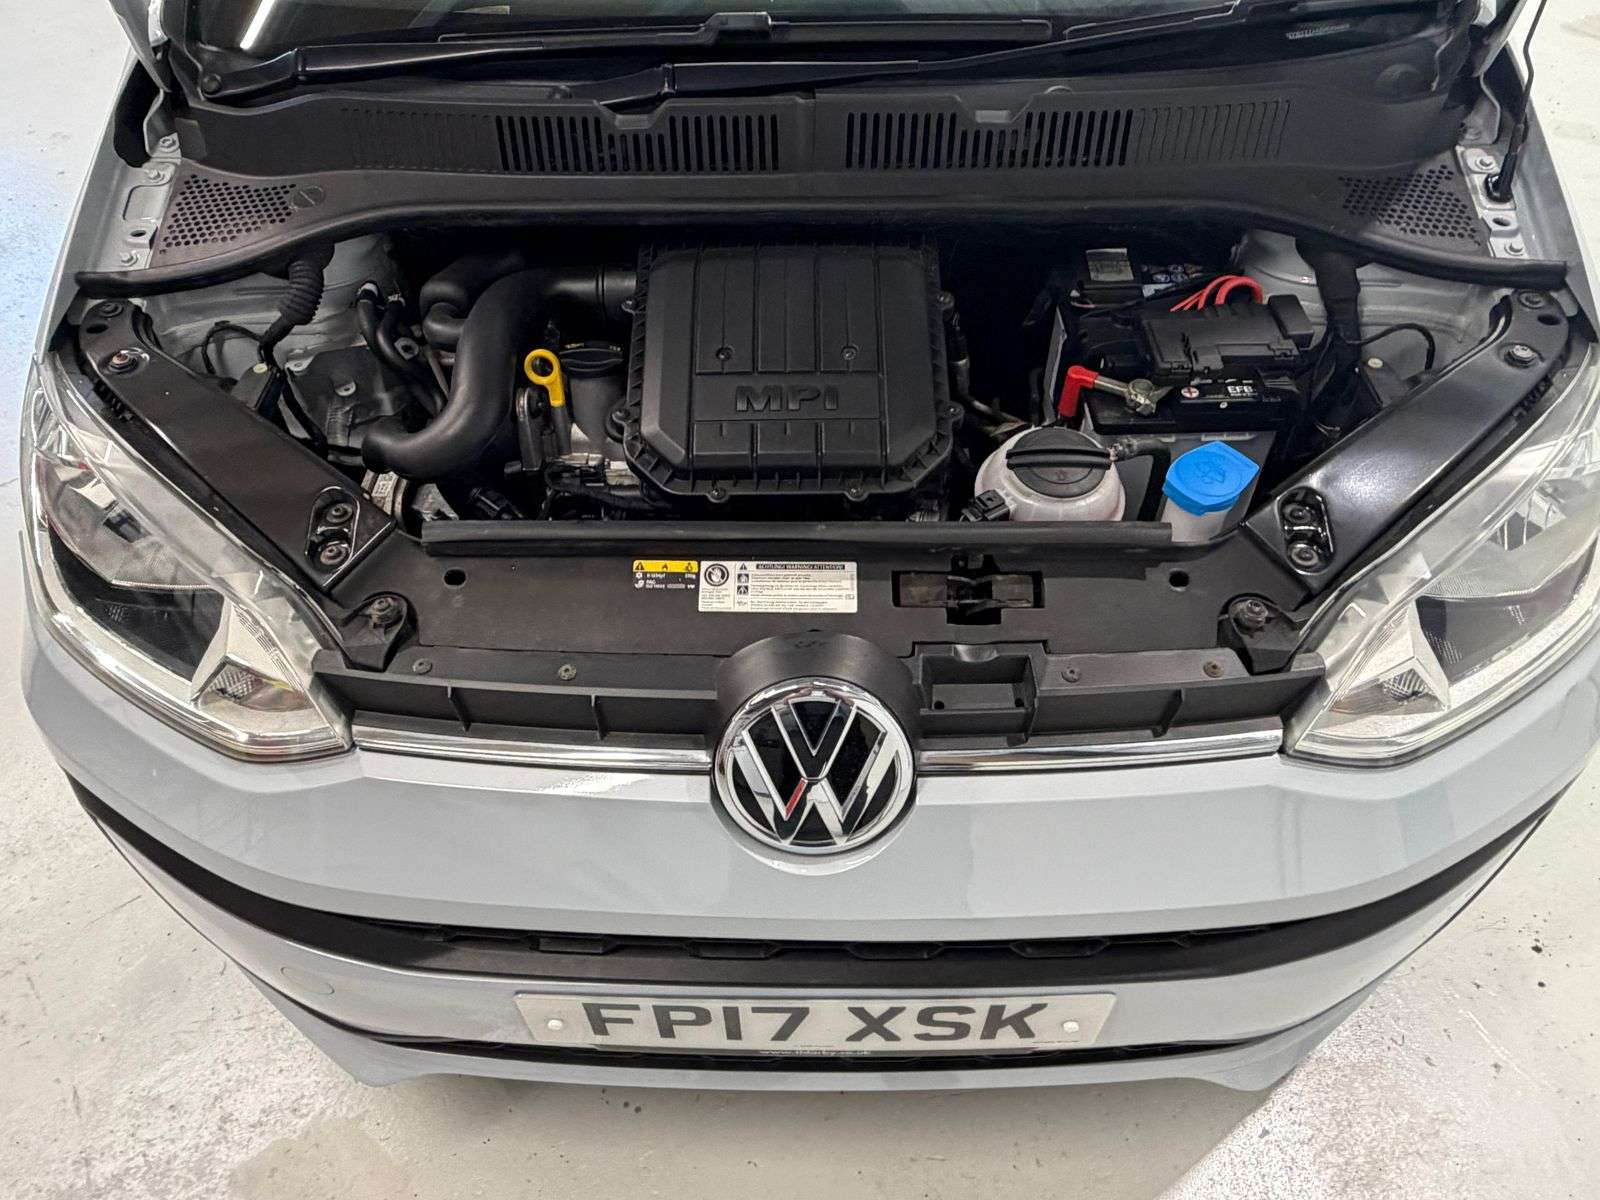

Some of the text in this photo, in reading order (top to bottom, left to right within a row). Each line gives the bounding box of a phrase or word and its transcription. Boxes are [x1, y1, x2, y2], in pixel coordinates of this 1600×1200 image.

[735, 385, 839, 412] MPI
[1227, 385, 1253, 394] EFB
[582, 1003, 1048, 1042] FP17 XSK
